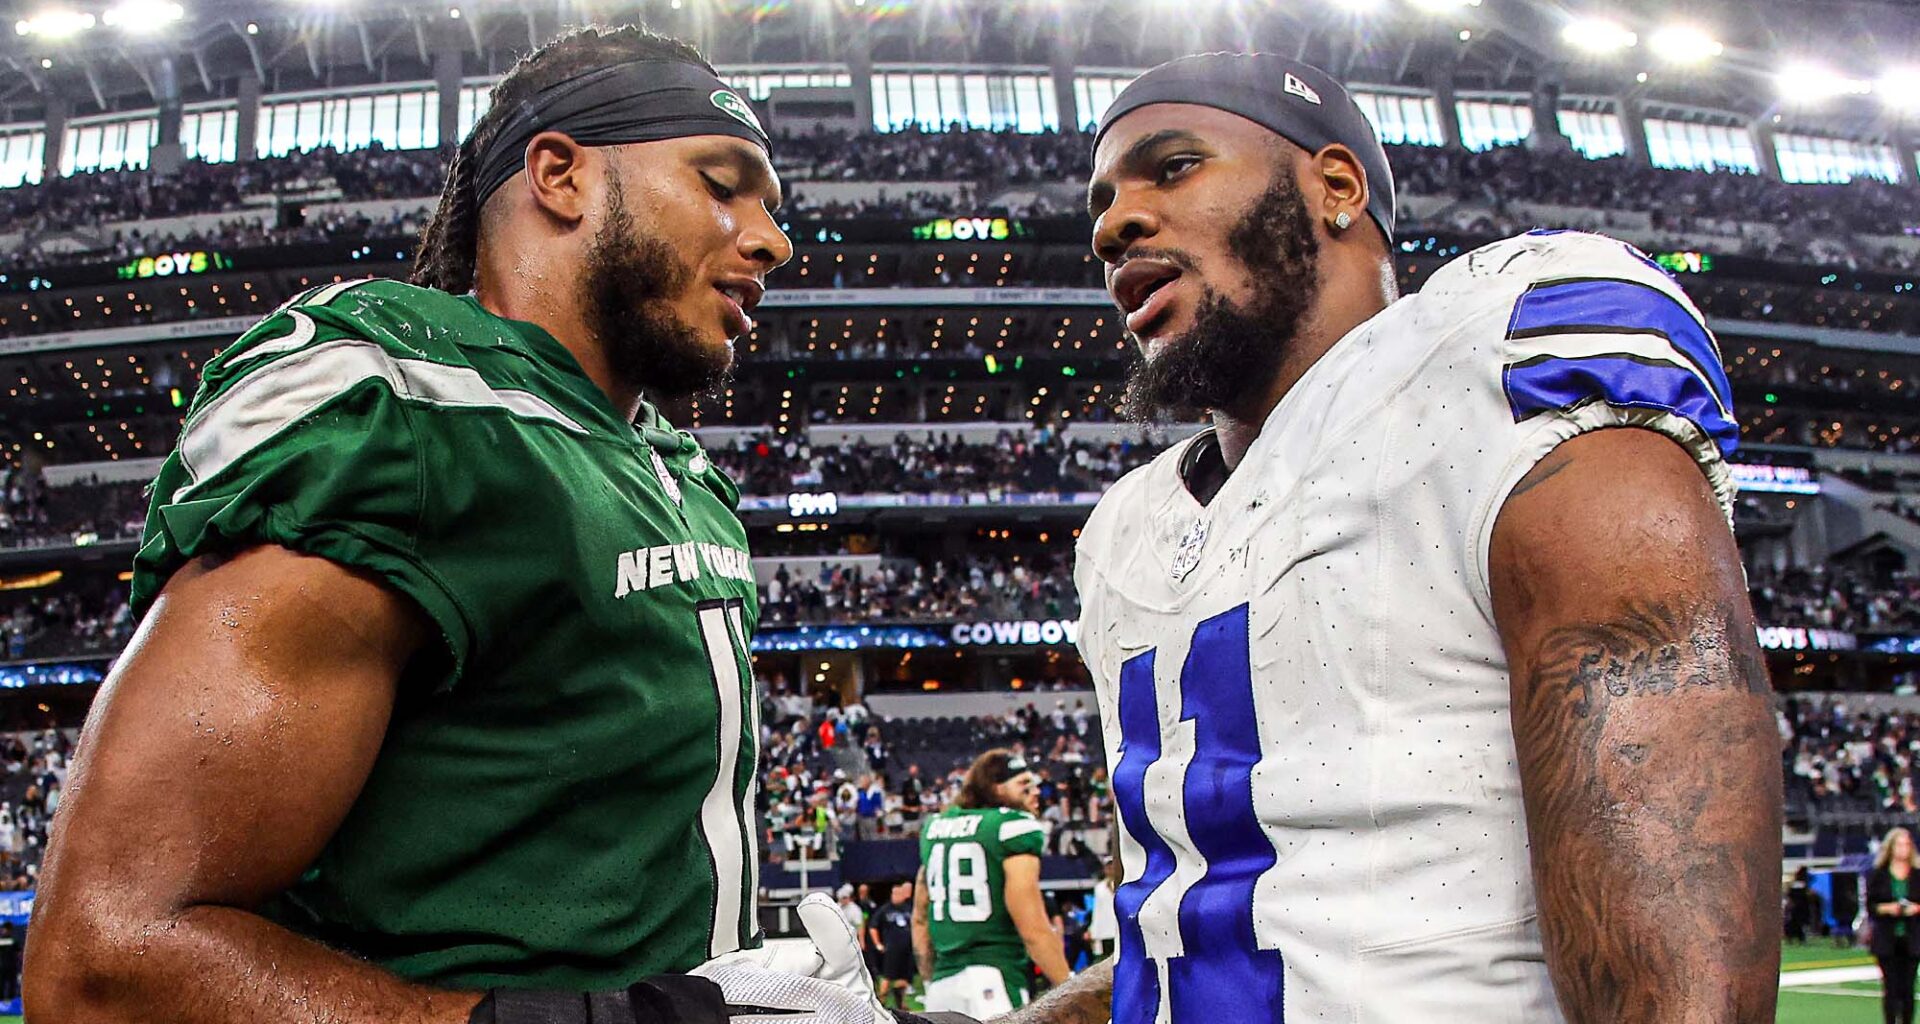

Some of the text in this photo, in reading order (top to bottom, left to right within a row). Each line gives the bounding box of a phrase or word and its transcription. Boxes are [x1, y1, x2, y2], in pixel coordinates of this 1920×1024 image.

[615, 541, 700, 598] NEW
[1111, 601, 1284, 1024] 11
[926, 841, 992, 922] 48
